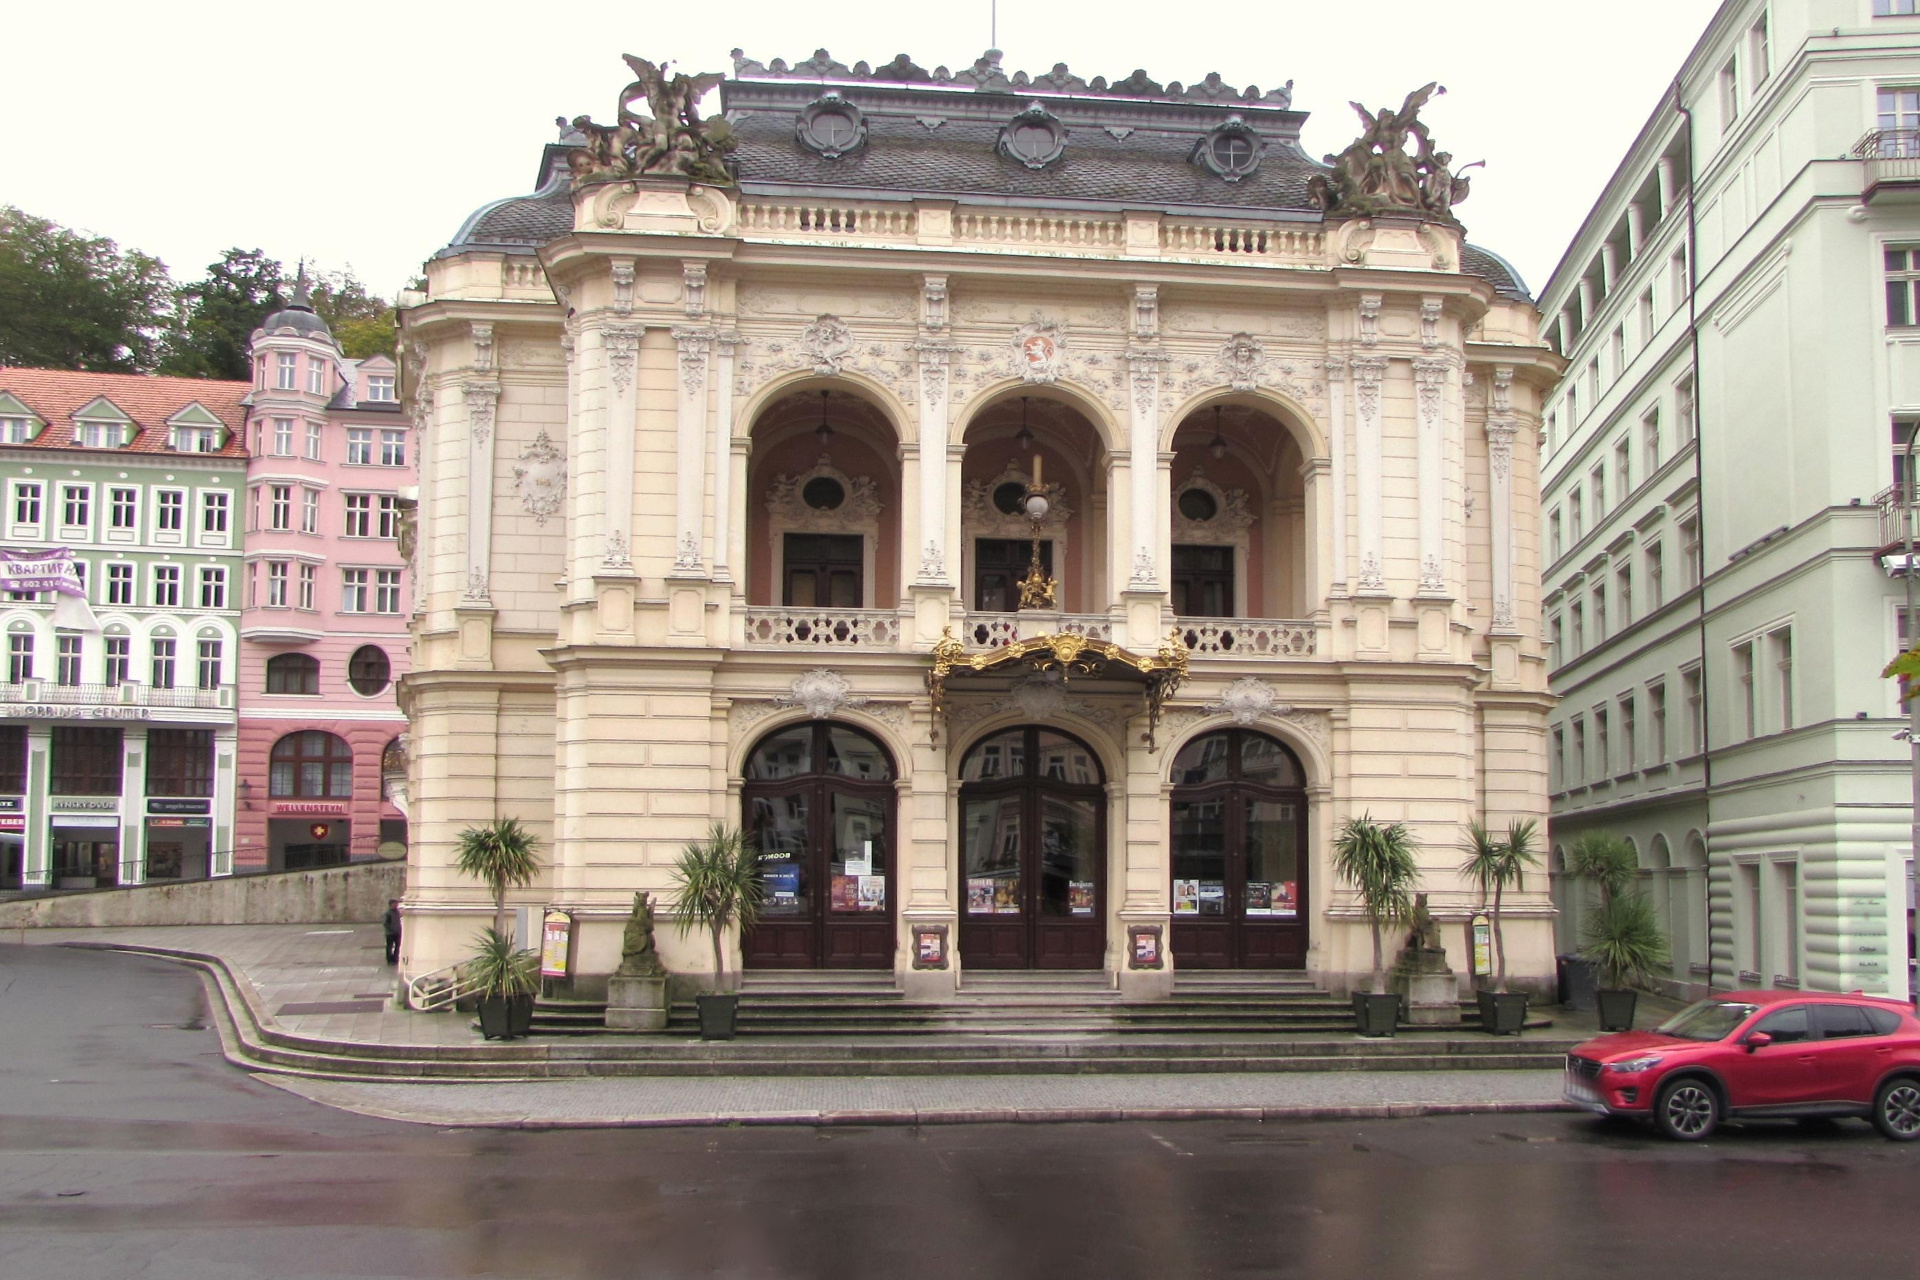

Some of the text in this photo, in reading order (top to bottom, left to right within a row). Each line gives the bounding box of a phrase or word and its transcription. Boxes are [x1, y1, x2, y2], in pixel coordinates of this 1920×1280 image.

[6, 705, 150, 718] SHOPPING CENTER
[276, 804, 343, 812] WELLENSTEYN
